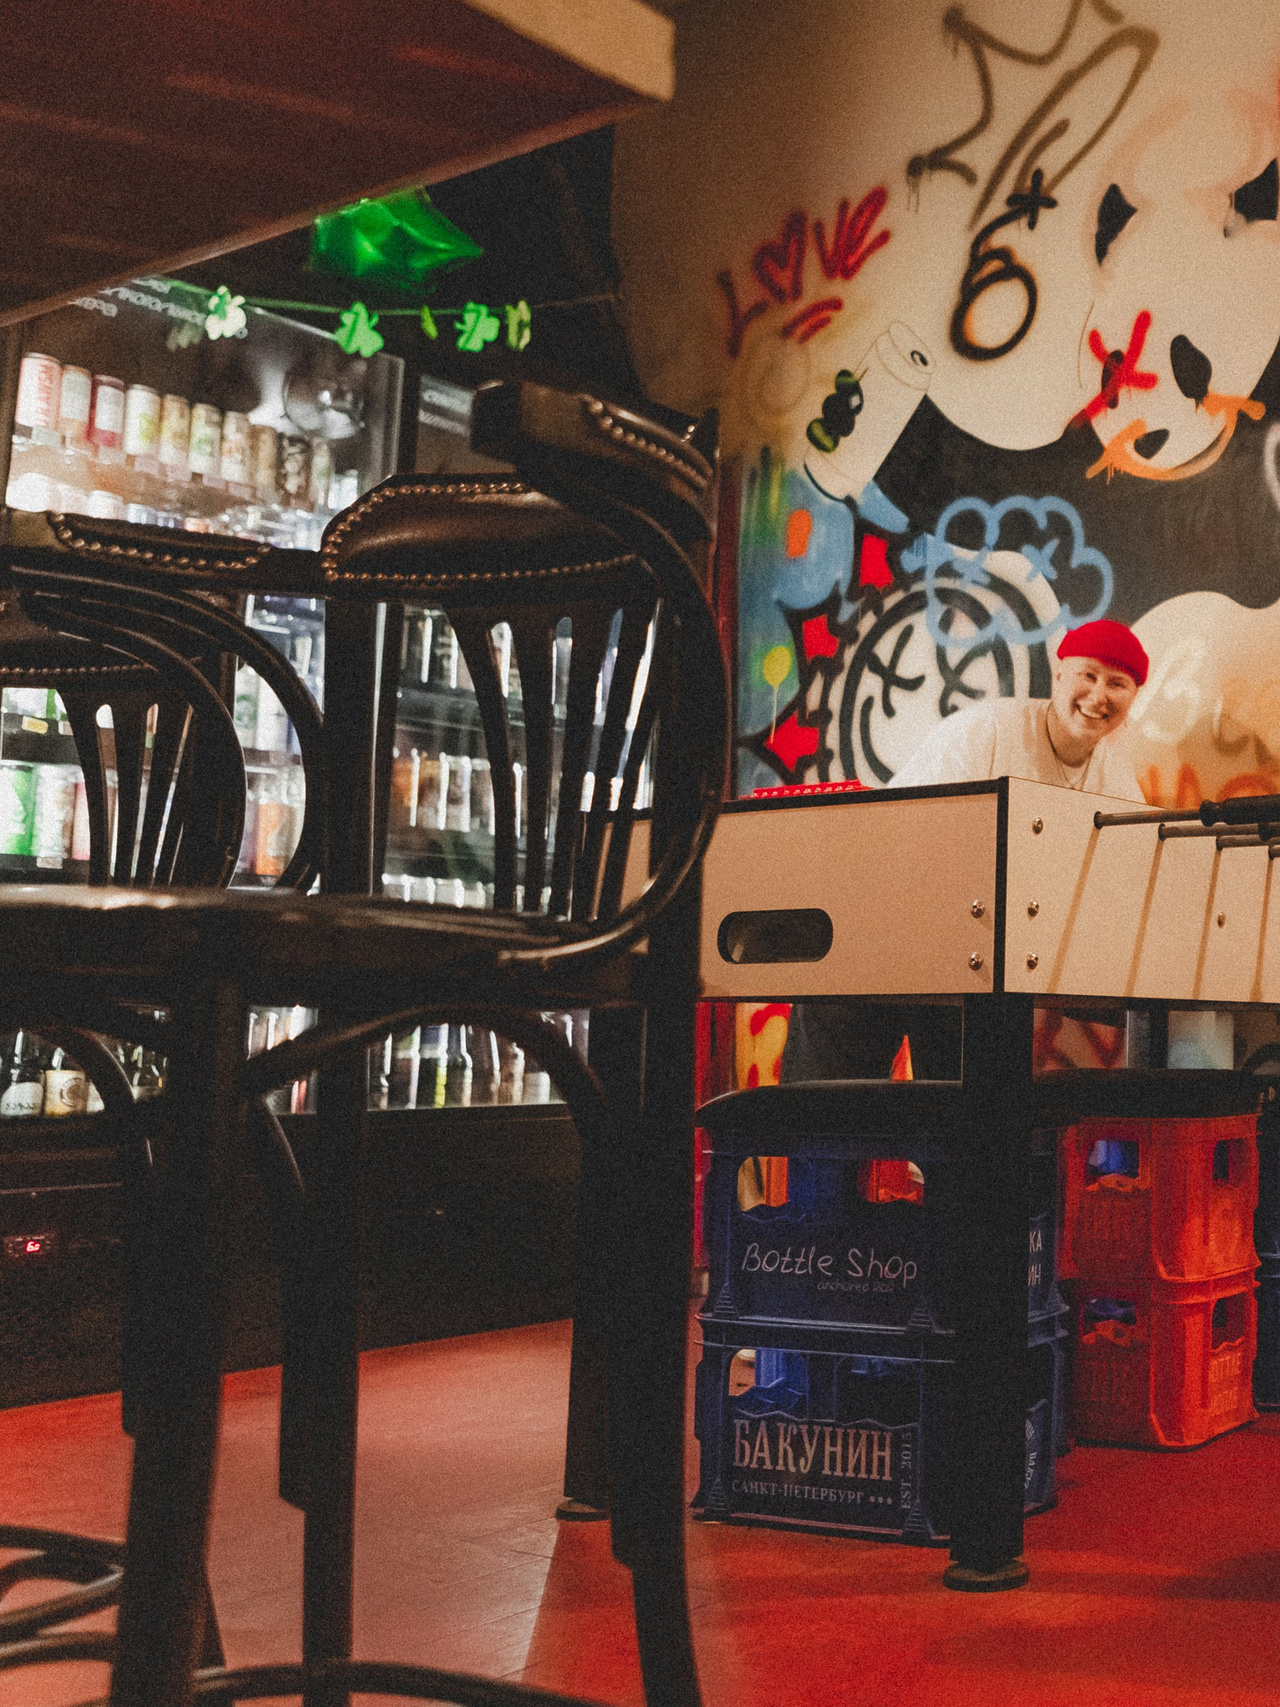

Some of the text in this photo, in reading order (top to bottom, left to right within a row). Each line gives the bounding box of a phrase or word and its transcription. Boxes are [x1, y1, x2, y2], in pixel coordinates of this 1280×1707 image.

[741, 1242, 918, 1289] Bottle Shop
[733, 1419, 893, 1482] БАКУНИН
[731, 1479, 865, 1505] САНКТ-ПЕТЕРБУРГ
